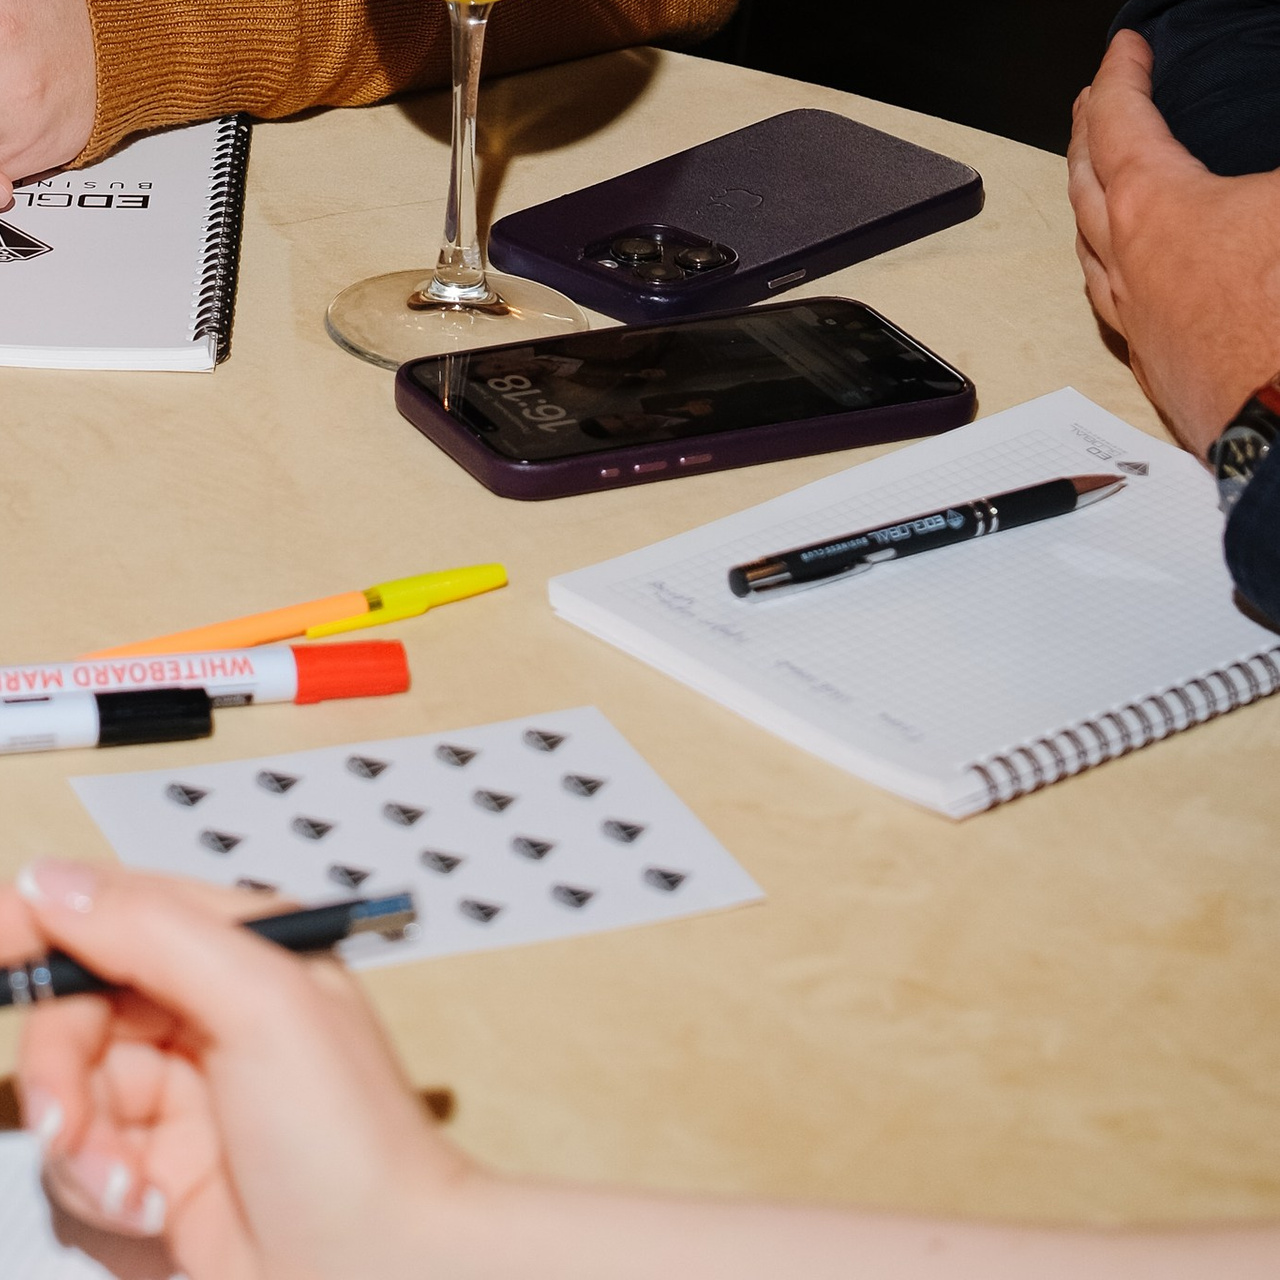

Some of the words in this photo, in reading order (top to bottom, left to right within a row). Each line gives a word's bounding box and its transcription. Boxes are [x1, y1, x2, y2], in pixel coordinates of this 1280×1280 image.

[1085, 446, 1113, 461] ED
[867, 514, 947, 545] EDGLOBAL
[72, 655, 255, 688] WHITEBOARD
